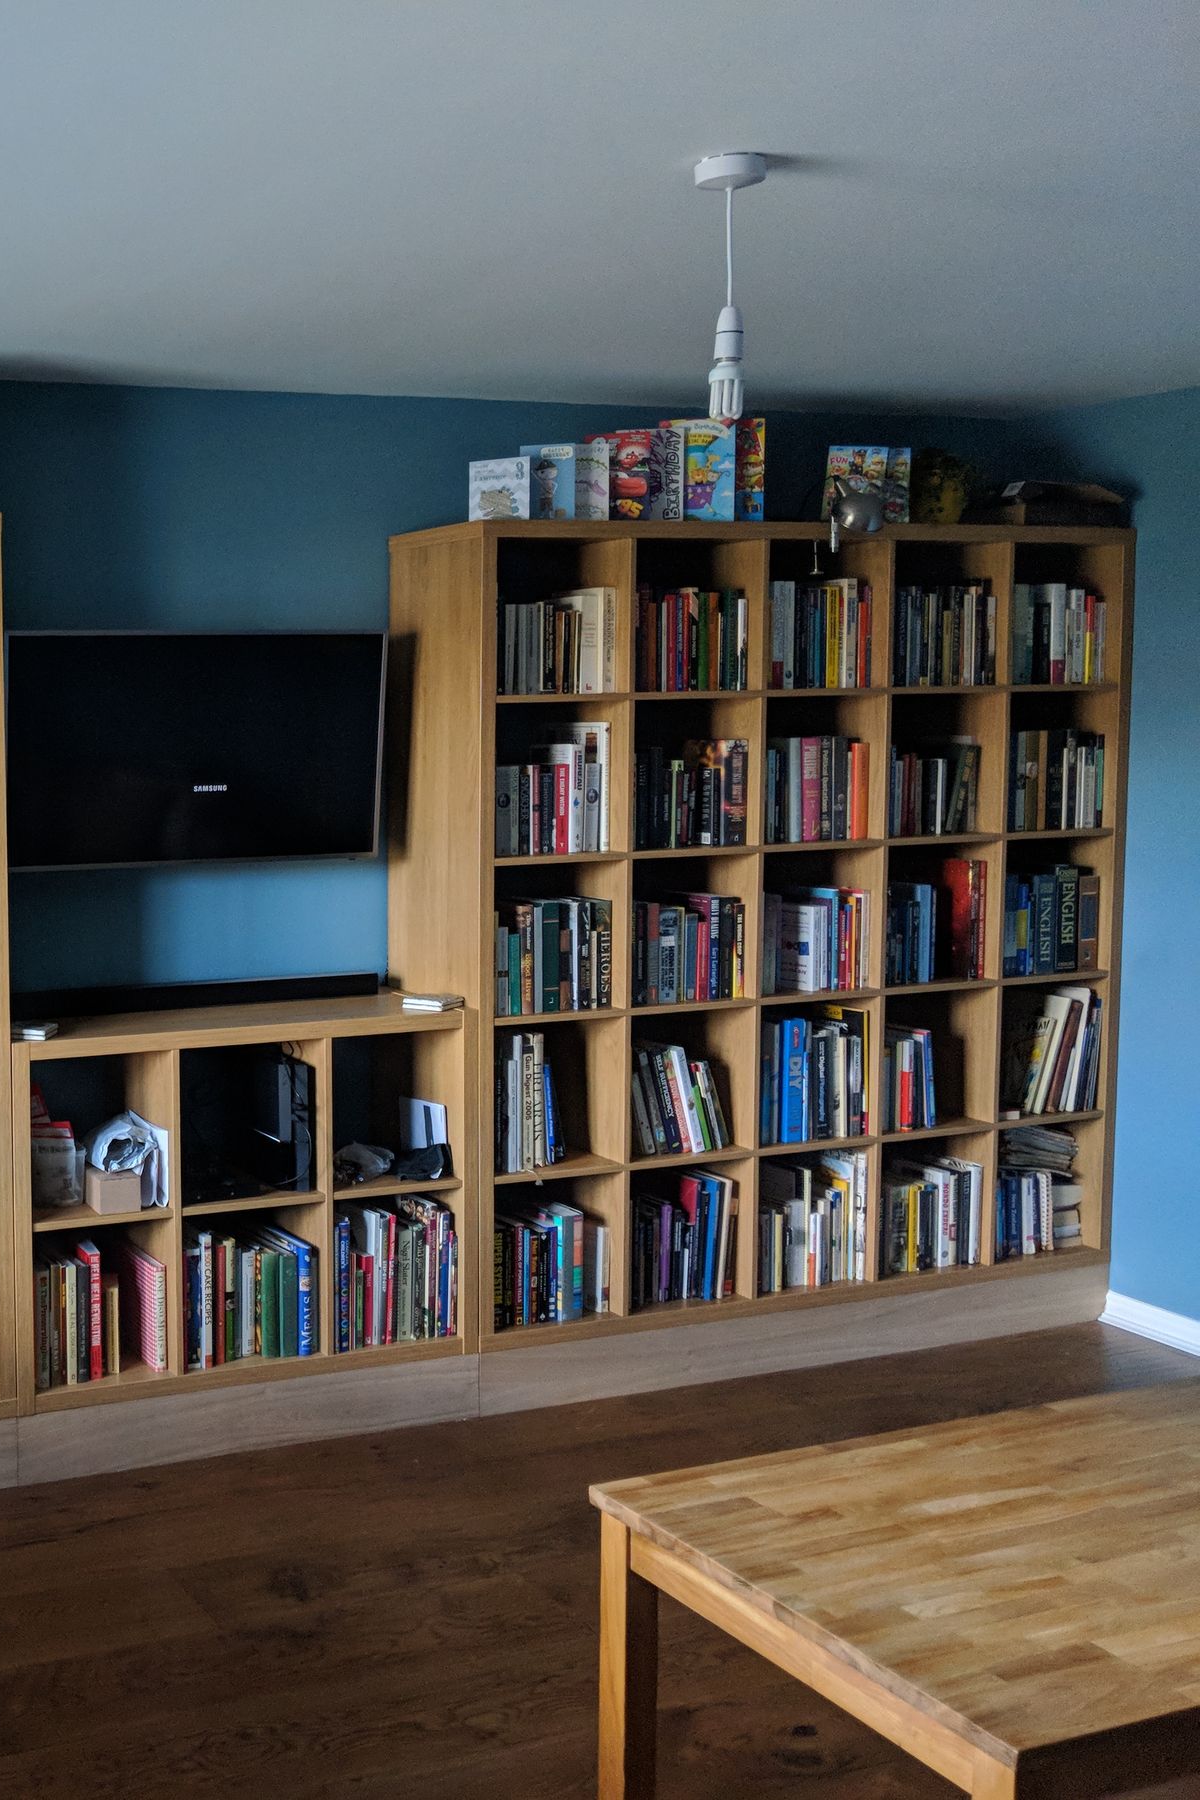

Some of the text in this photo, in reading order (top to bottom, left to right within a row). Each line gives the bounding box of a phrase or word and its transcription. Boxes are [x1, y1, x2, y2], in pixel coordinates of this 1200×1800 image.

[663, 430, 681, 520] BIRTHDAY
[830, 457, 848, 465] FUN
[193, 784, 227, 792] SAMSUNG
[1038, 897, 1051, 962] ENGLISH
[1060, 882, 1076, 945] ENGLISH
[600, 931, 610, 993] HEROES
[524, 1073, 533, 1098] Digest
[789, 1055, 802, 1090] DIY
[340, 1272, 349, 1336] COOKBOOK
